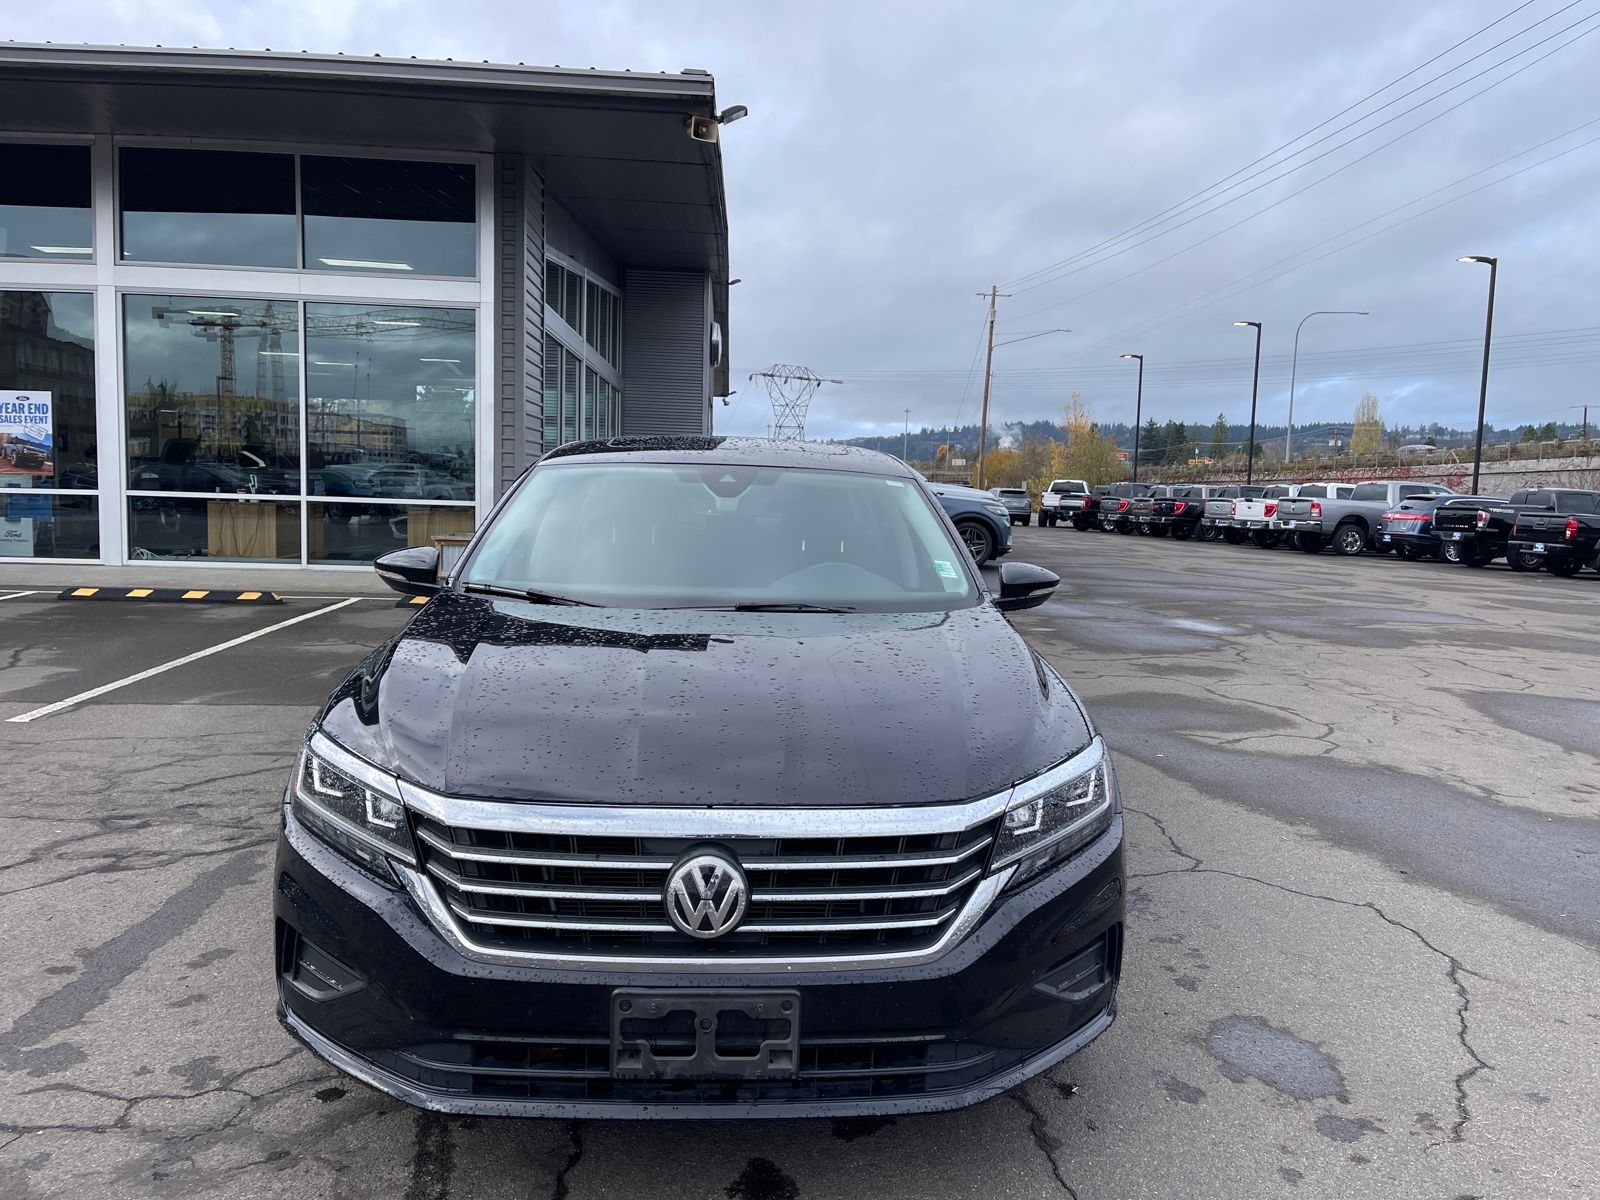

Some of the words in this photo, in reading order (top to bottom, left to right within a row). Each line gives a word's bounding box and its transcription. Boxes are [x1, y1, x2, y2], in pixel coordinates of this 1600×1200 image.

[0, 403, 25, 414] YEAR
[28, 404, 48, 414] END
[0, 415, 22, 424] SALES
[24, 416, 48, 424] EVENT
